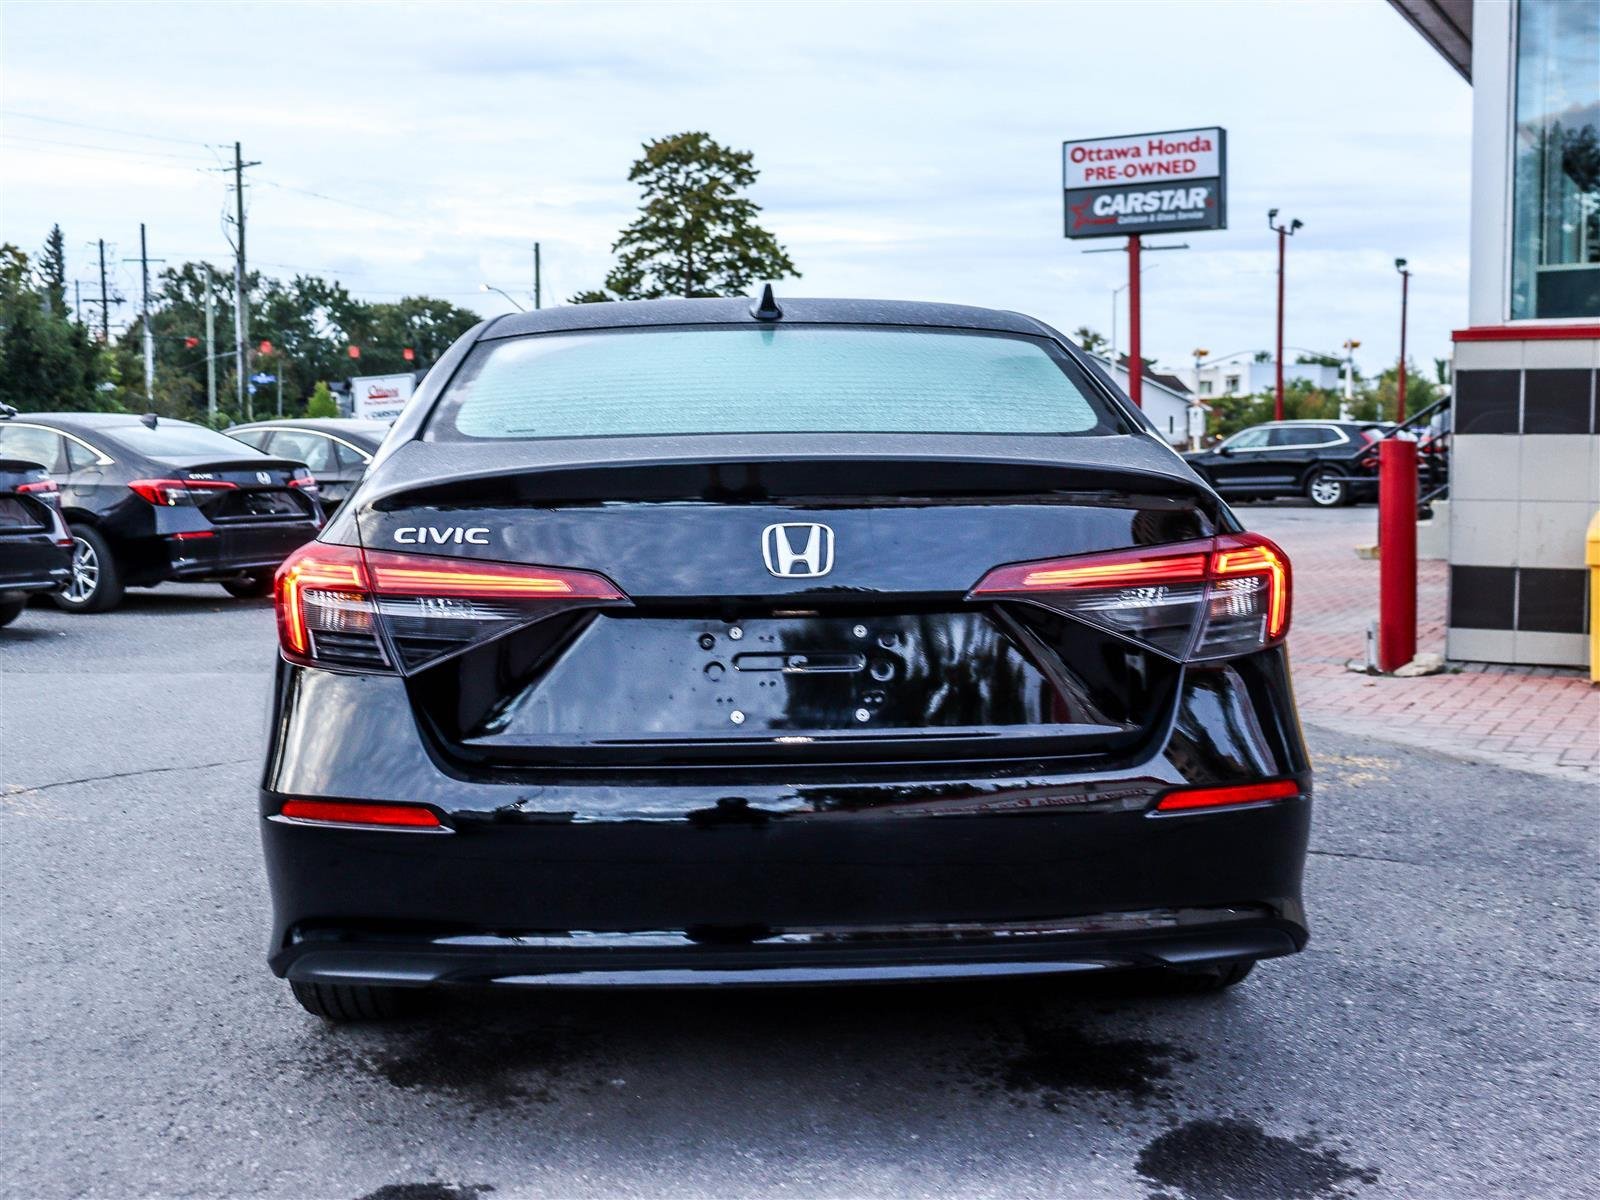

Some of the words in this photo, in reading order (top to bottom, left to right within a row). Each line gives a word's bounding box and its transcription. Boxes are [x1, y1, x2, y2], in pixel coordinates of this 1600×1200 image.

[1071, 146, 1141, 163] Ottawa
[1148, 136, 1212, 156] Honda
[1085, 159, 1196, 181] PRE-OWNED
[1093, 187, 1208, 216] CARSTAR
[393, 527, 490, 544] CIVIC
